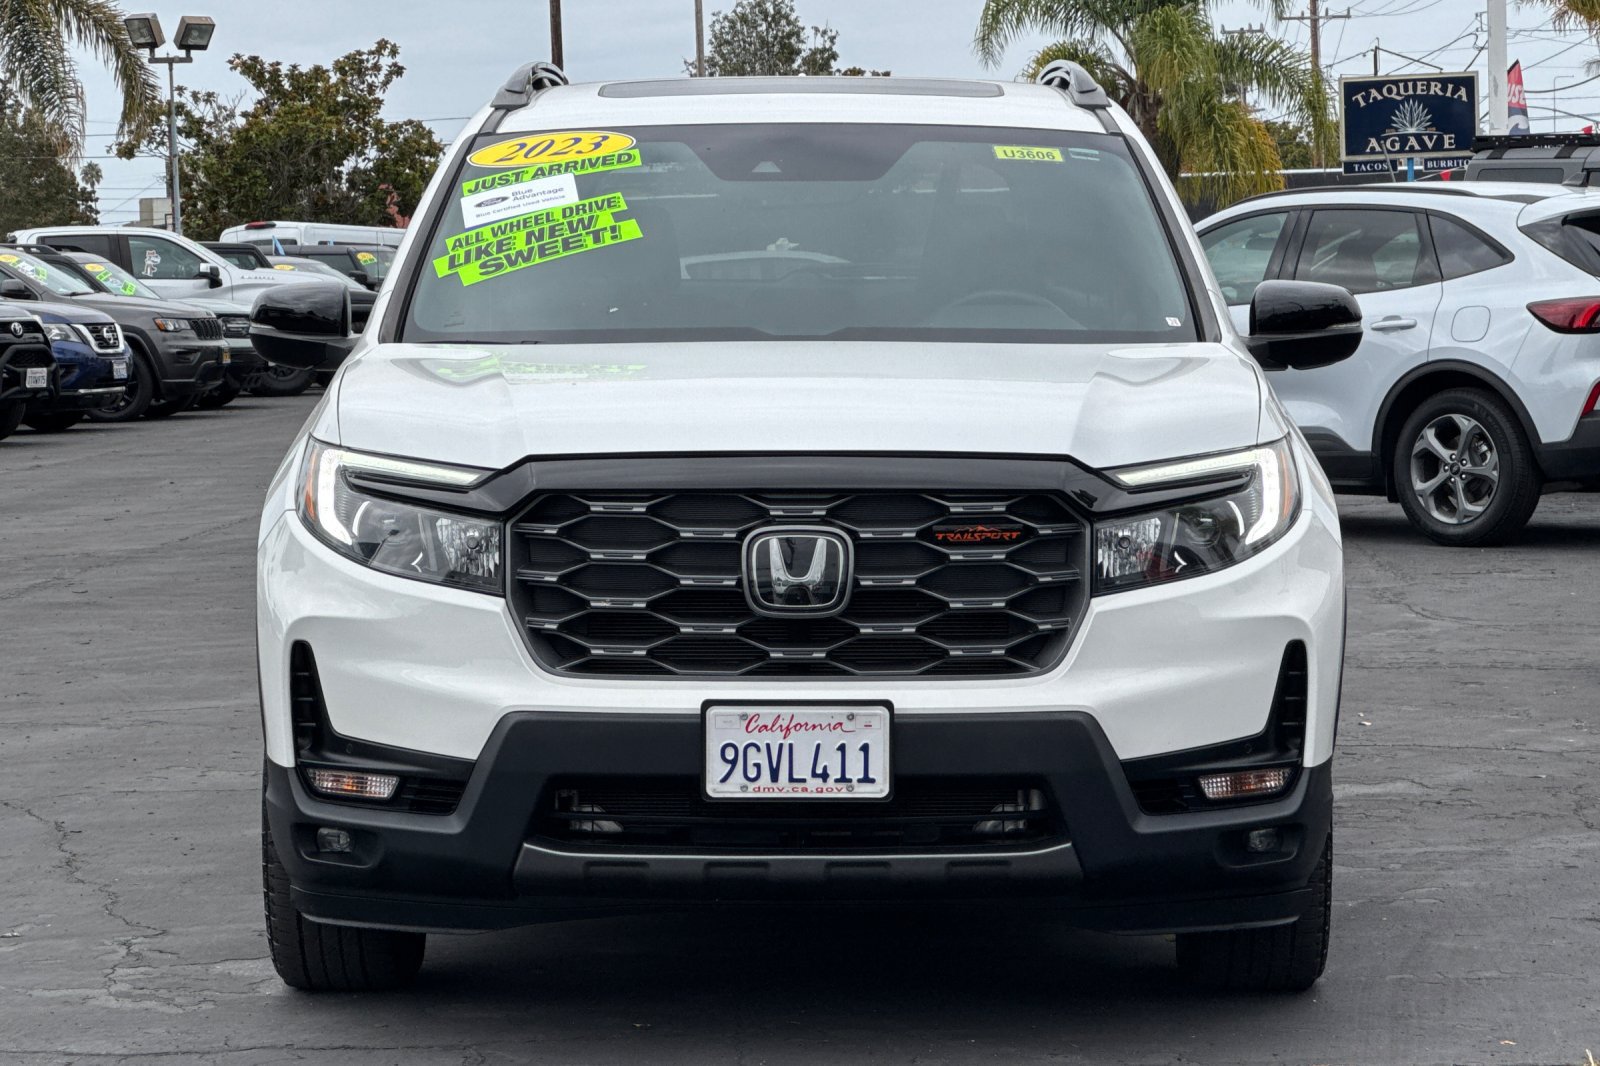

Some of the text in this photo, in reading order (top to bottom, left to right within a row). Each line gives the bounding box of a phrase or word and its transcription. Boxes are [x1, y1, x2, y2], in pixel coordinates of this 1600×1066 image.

[1352, 81, 1469, 108] TAQUERIA
[495, 135, 610, 163] 2023
[1003, 149, 1056, 160] U3606
[1366, 134, 1456, 153] AGAVE
[467, 152, 636, 194] JUST ARRIVED
[1353, 162, 1389, 172] TACOS
[512, 188, 533, 197] Blue
[513, 187, 565, 201] Advantage
[493, 204, 521, 214] Certified
[542, 195, 566, 203] Vehicle
[450, 195, 622, 251] ALL WHEEL DRIVE
[448, 215, 599, 270] LIKE NEW
[478, 224, 623, 276] SWEET!
[935, 531, 1021, 541] TRAILSPORT
[745, 713, 856, 740] California
[719, 742, 876, 784] 9GVL411
[752, 786, 844, 794] dmv.ca.gov
